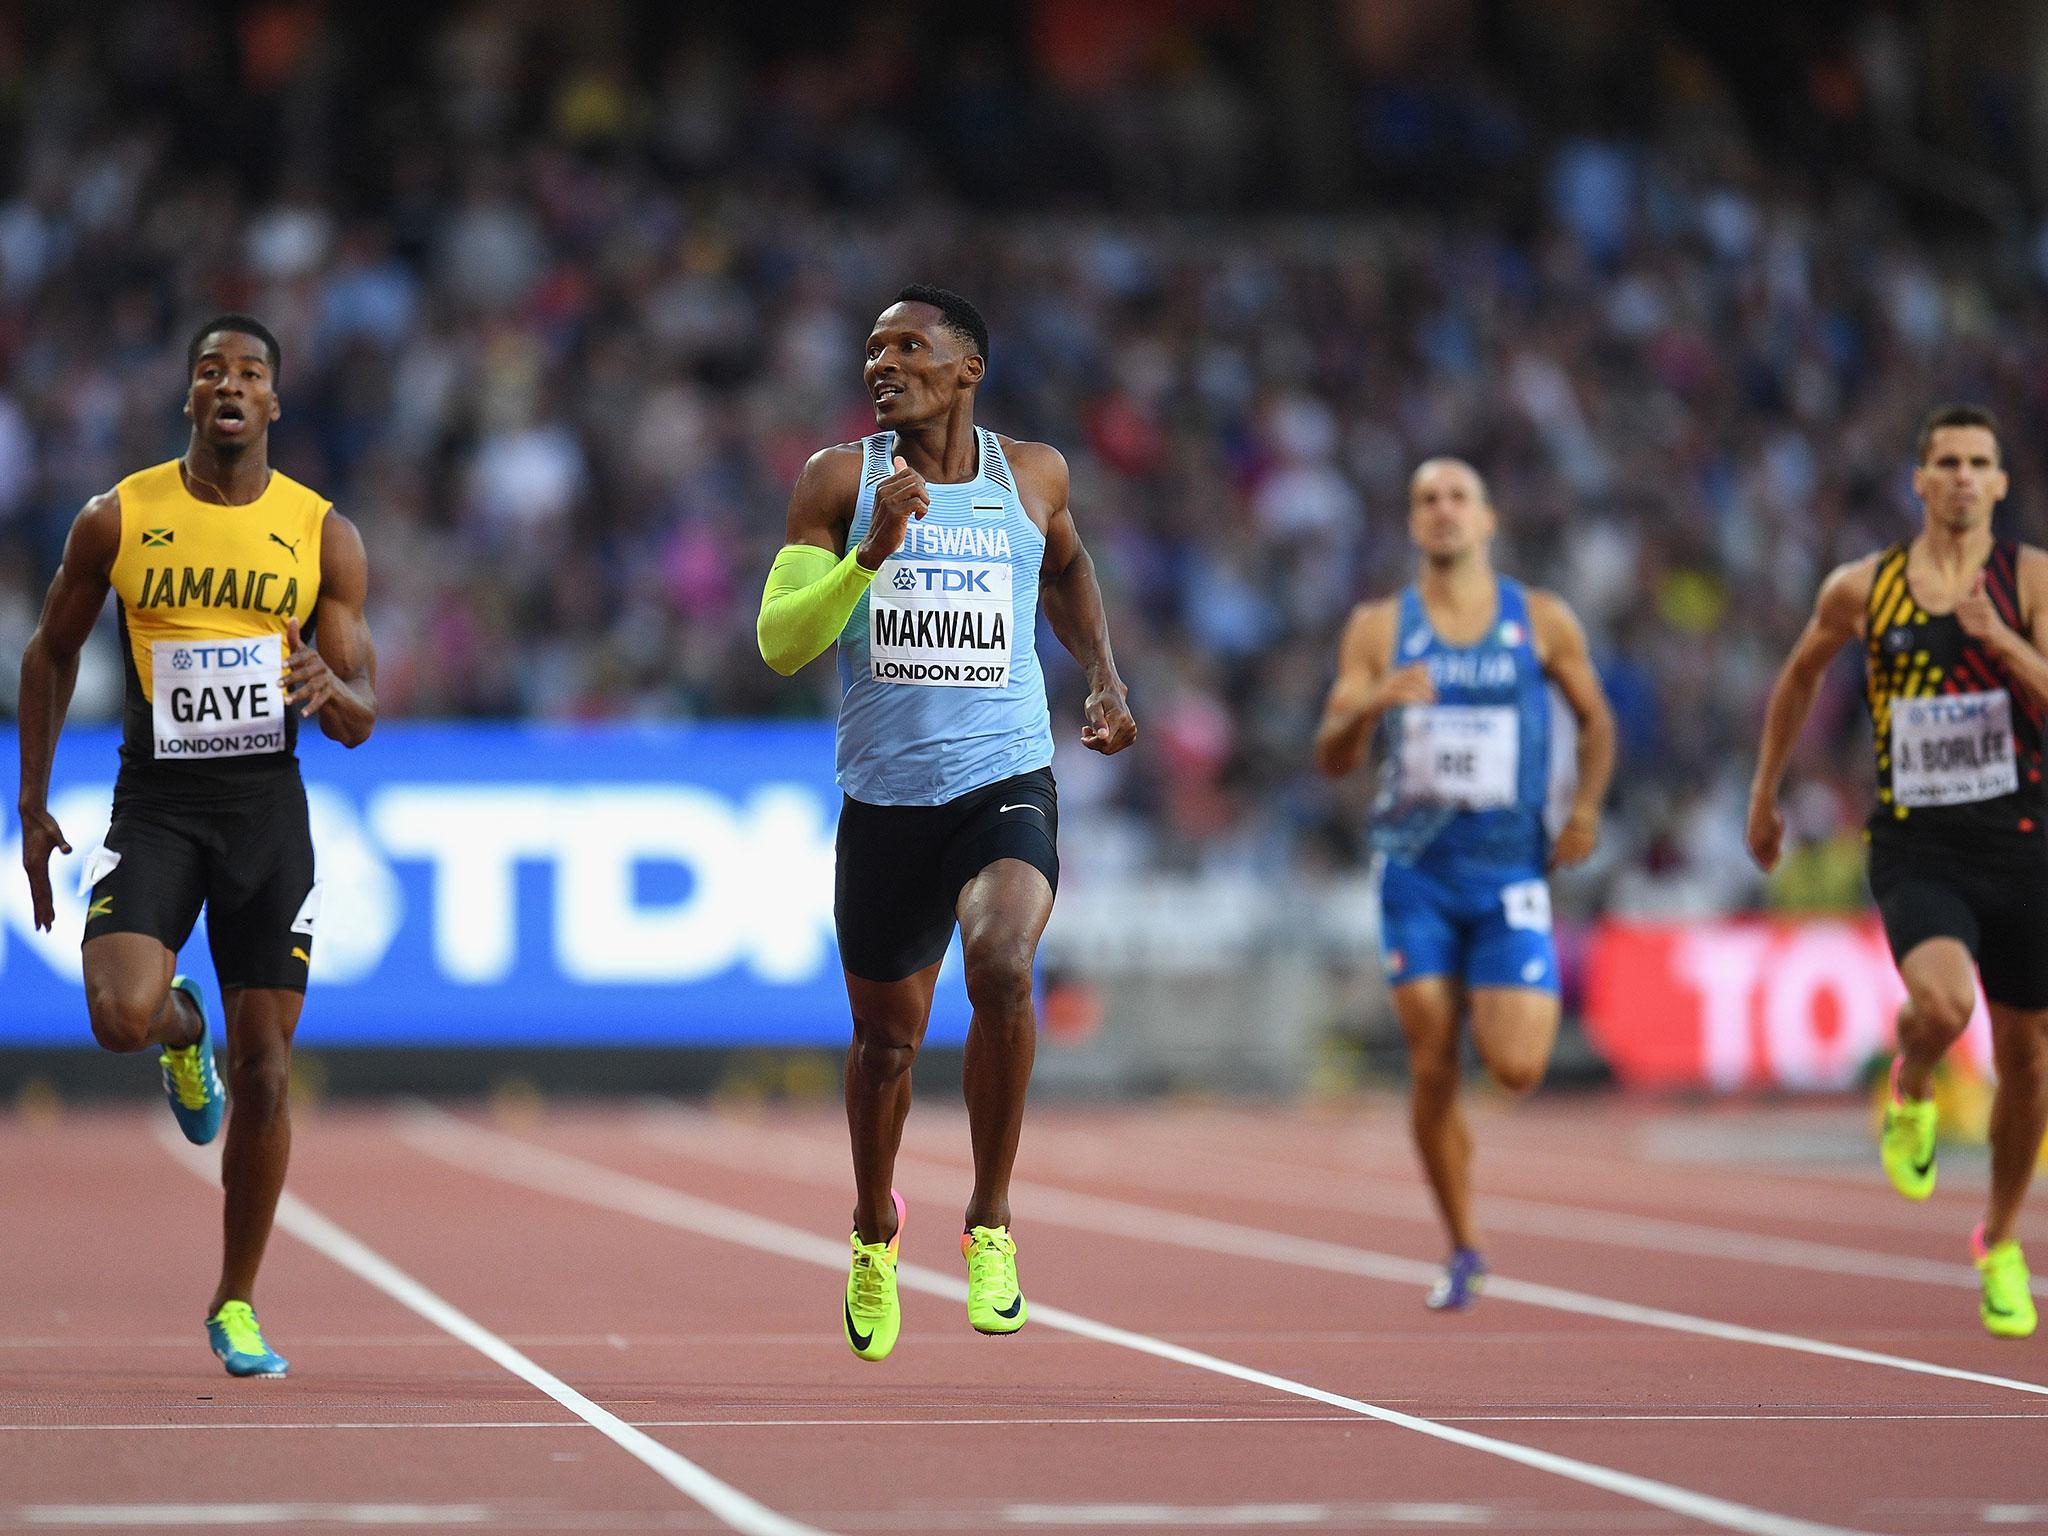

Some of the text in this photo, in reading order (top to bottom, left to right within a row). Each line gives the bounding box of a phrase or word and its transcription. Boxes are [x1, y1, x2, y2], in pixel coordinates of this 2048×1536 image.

[896, 523, 1012, 559] TSWANA
[137, 567, 298, 618] JAMAICA
[916, 567, 992, 593] TDK
[875, 608, 1006, 650] MAKWALA
[192, 644, 263, 670] TDK
[875, 661, 1006, 683] LONDON 2017
[170, 683, 269, 723] GAYE
[159, 732, 282, 754] LONDON 2017
